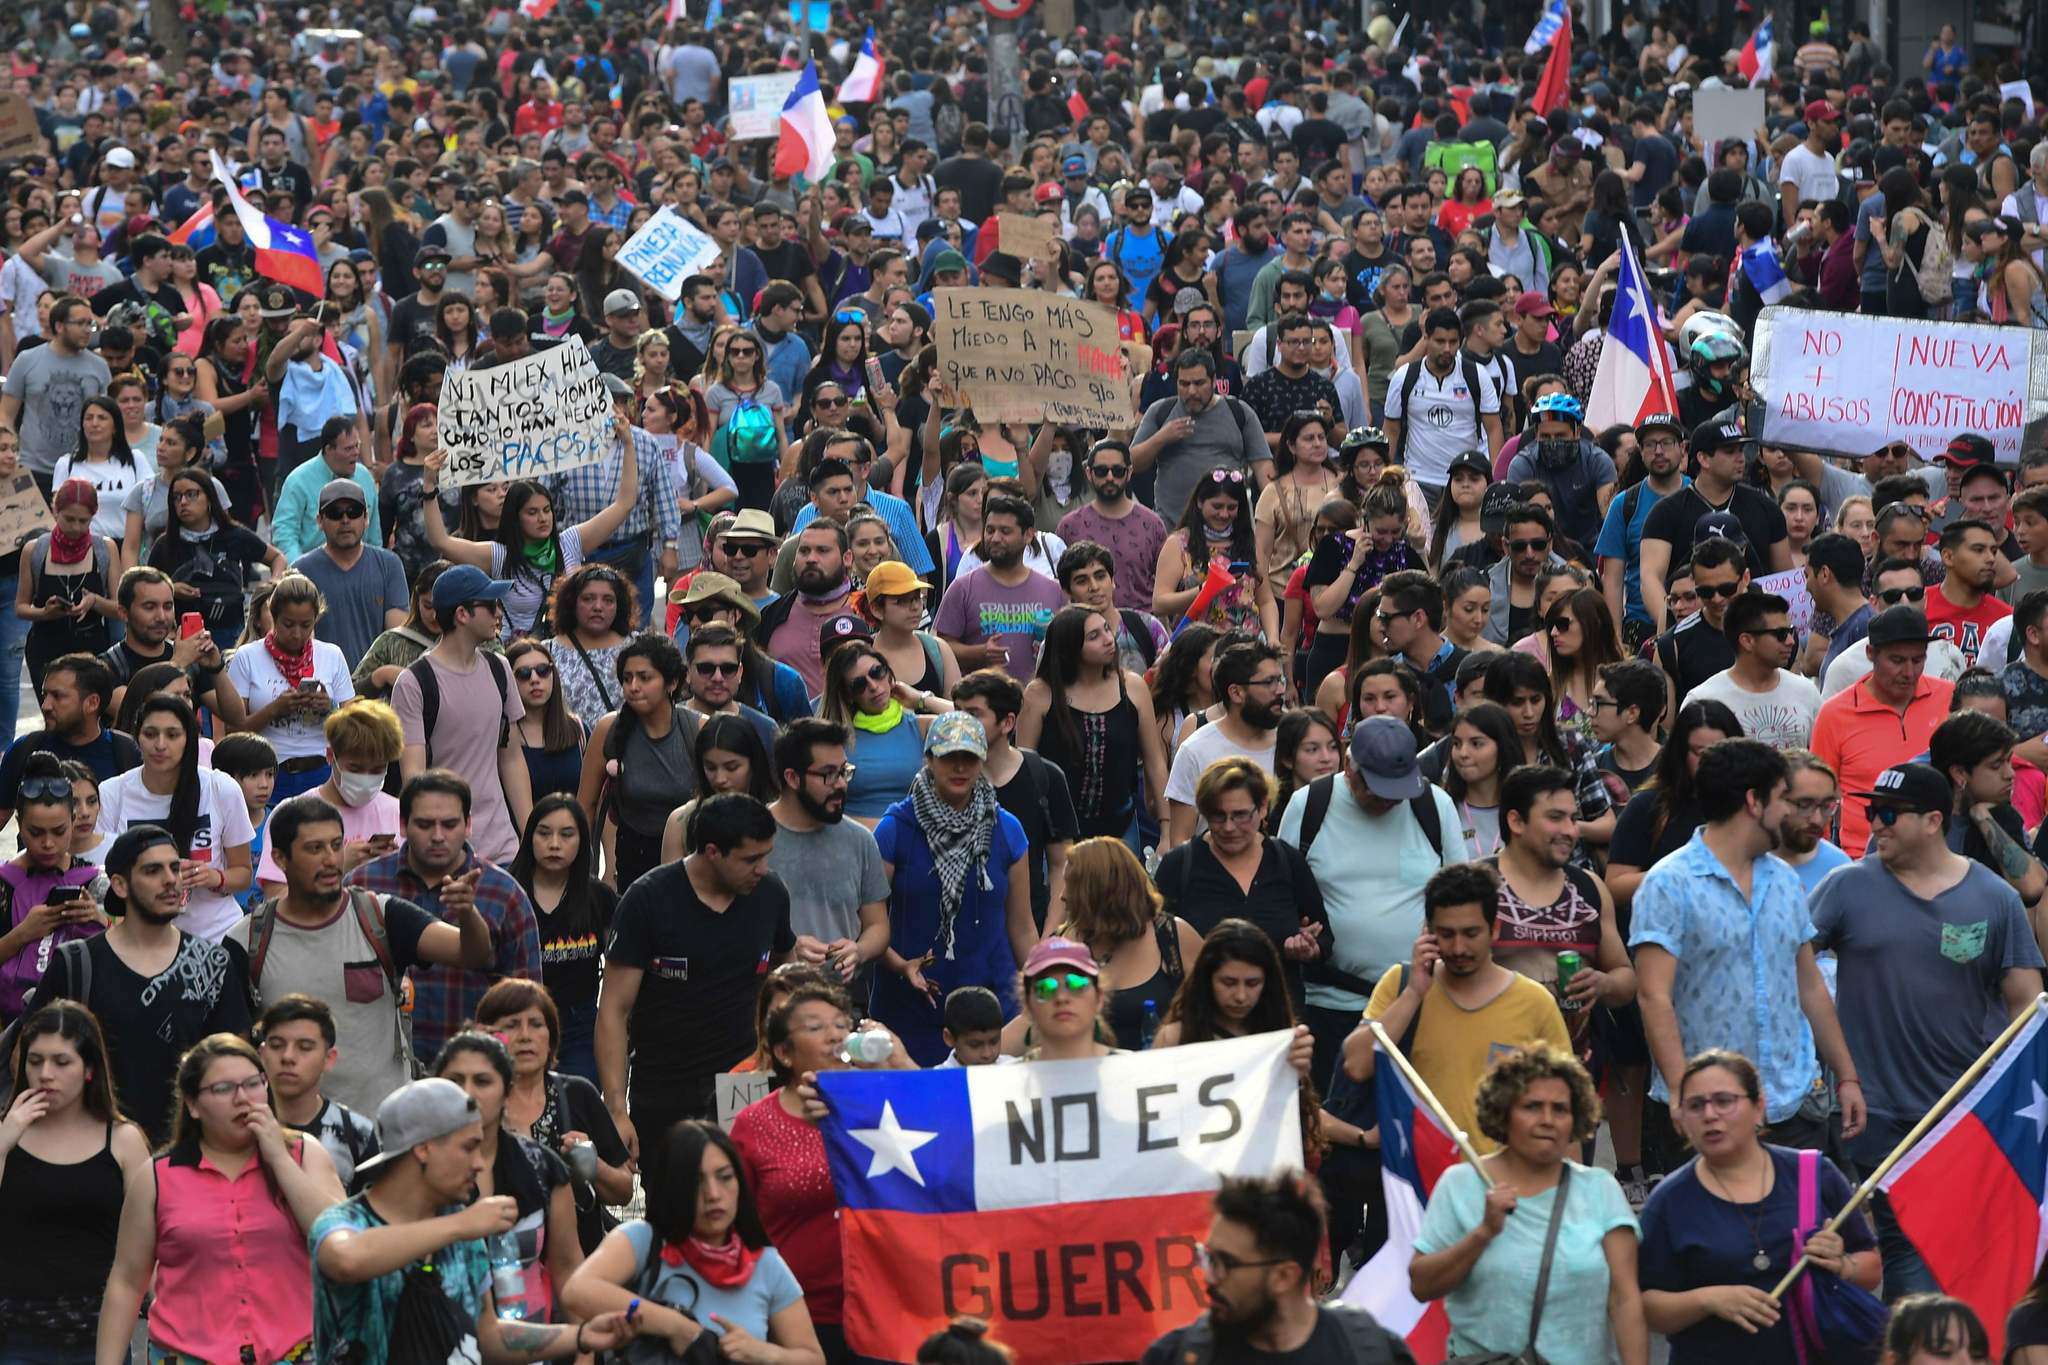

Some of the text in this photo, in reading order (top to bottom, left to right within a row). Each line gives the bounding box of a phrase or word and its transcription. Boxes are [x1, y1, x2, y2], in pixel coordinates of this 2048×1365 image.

[947, 295, 1094, 338] LE TENGO MÁS
[1023, 328, 1037, 352] A
[1803, 329, 1843, 357] NO
[1908, 334, 2011, 373] NUEVA
[524, 359, 551, 388] EX
[985, 367, 997, 384] A
[1030, 362, 1077, 391] PACO
[443, 427, 490, 449] COMO
[519, 415, 557, 434] HAN
[563, 398, 608, 424] HECHO
[451, 394, 545, 427] TANTOS
[1780, 391, 1871, 427] ABUSOS
[450, 452, 486, 473] LOS
[1005, 1072, 1242, 1166] NO ES
